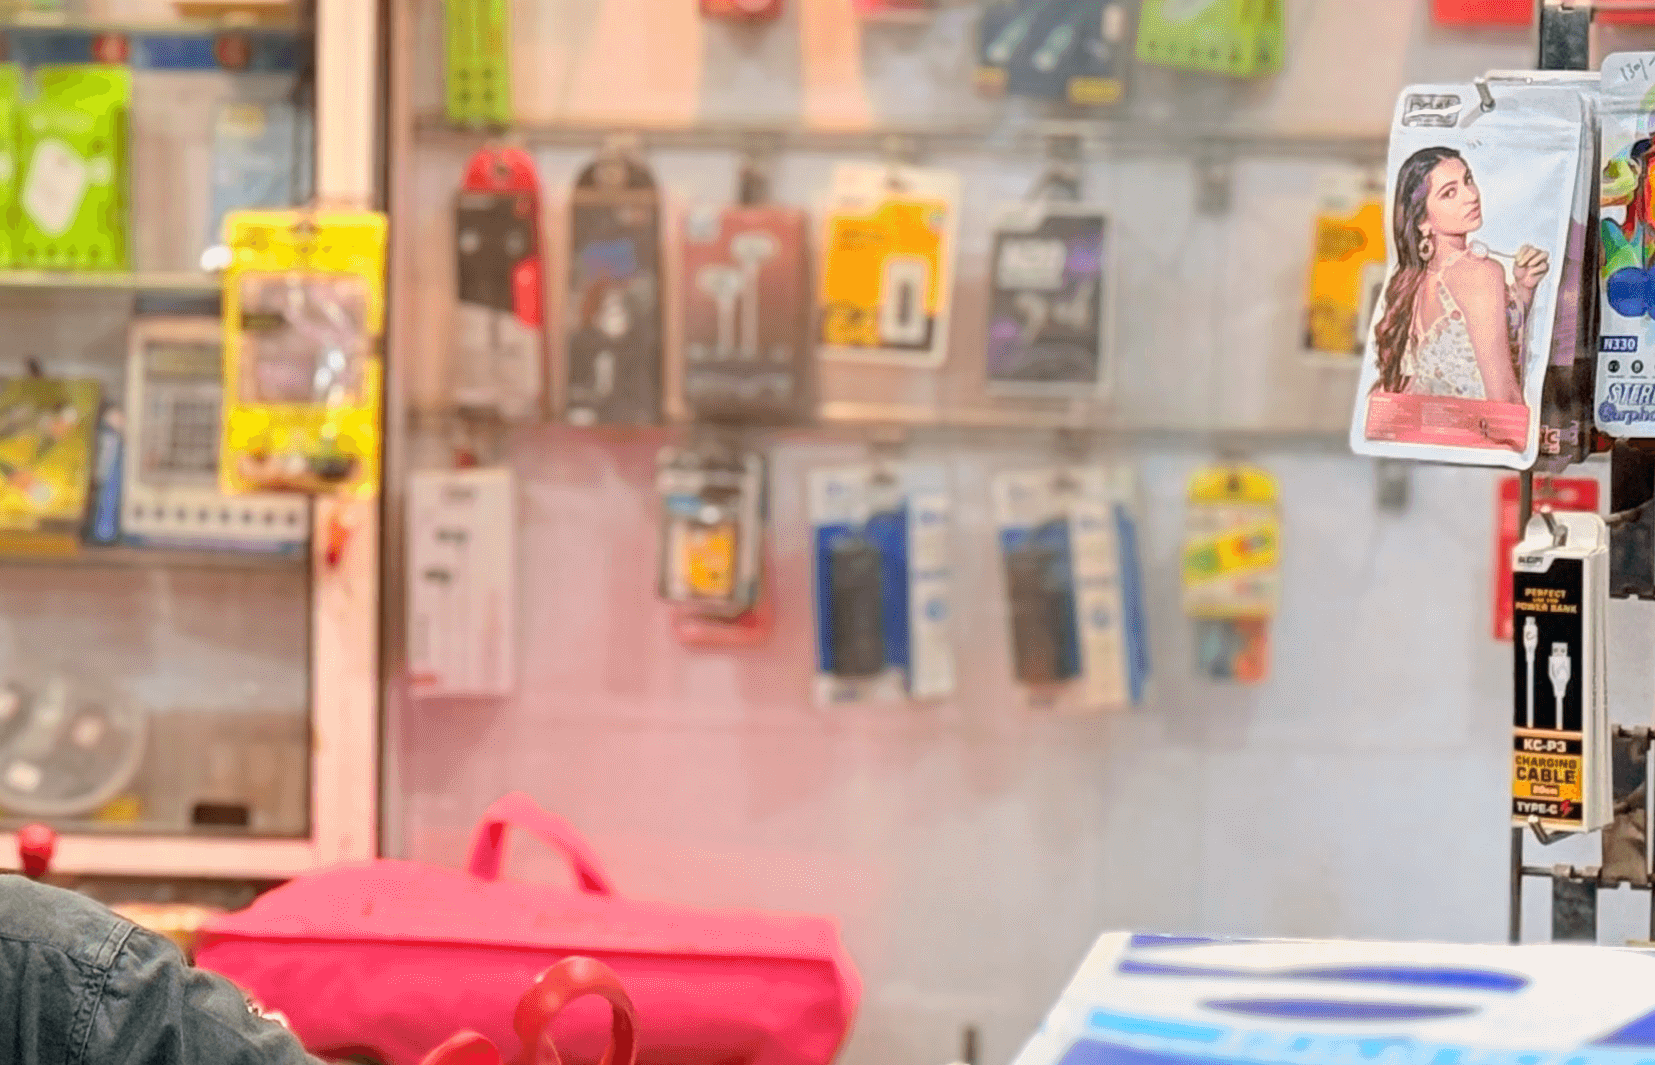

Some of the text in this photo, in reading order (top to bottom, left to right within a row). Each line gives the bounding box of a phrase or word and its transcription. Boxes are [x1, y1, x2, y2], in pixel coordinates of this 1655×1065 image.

[1524, 588, 1566, 598] PERFECT
[1523, 738, 1566, 753] KC-P3
[1515, 756, 1577, 769] CHARGING
[1516, 766, 1576, 785] CABLE
[1517, 801, 1558, 815] TYPE-C
